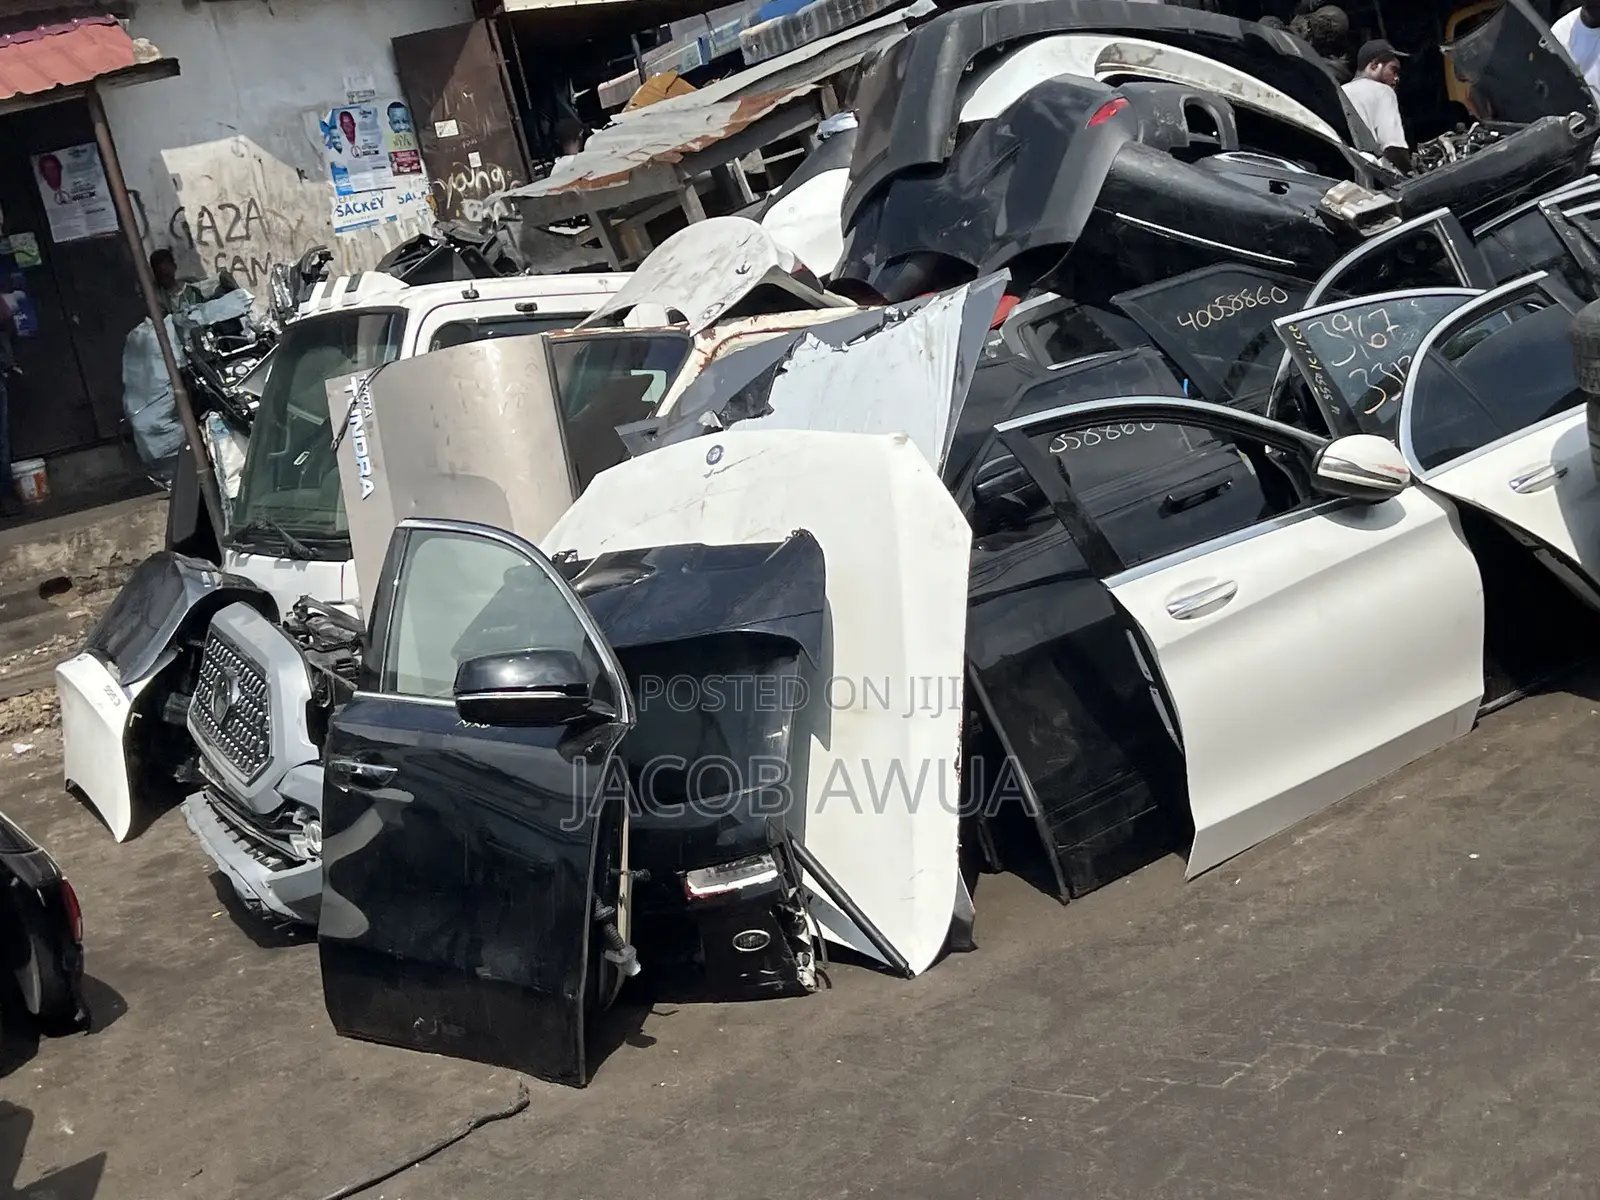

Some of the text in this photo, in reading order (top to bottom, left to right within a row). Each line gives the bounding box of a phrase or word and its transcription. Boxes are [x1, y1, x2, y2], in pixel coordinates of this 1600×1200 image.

[335, 196, 385, 218] SACKEY
[1177, 285, 1289, 332] 40058860
[343, 376, 376, 501] TUNDRA
